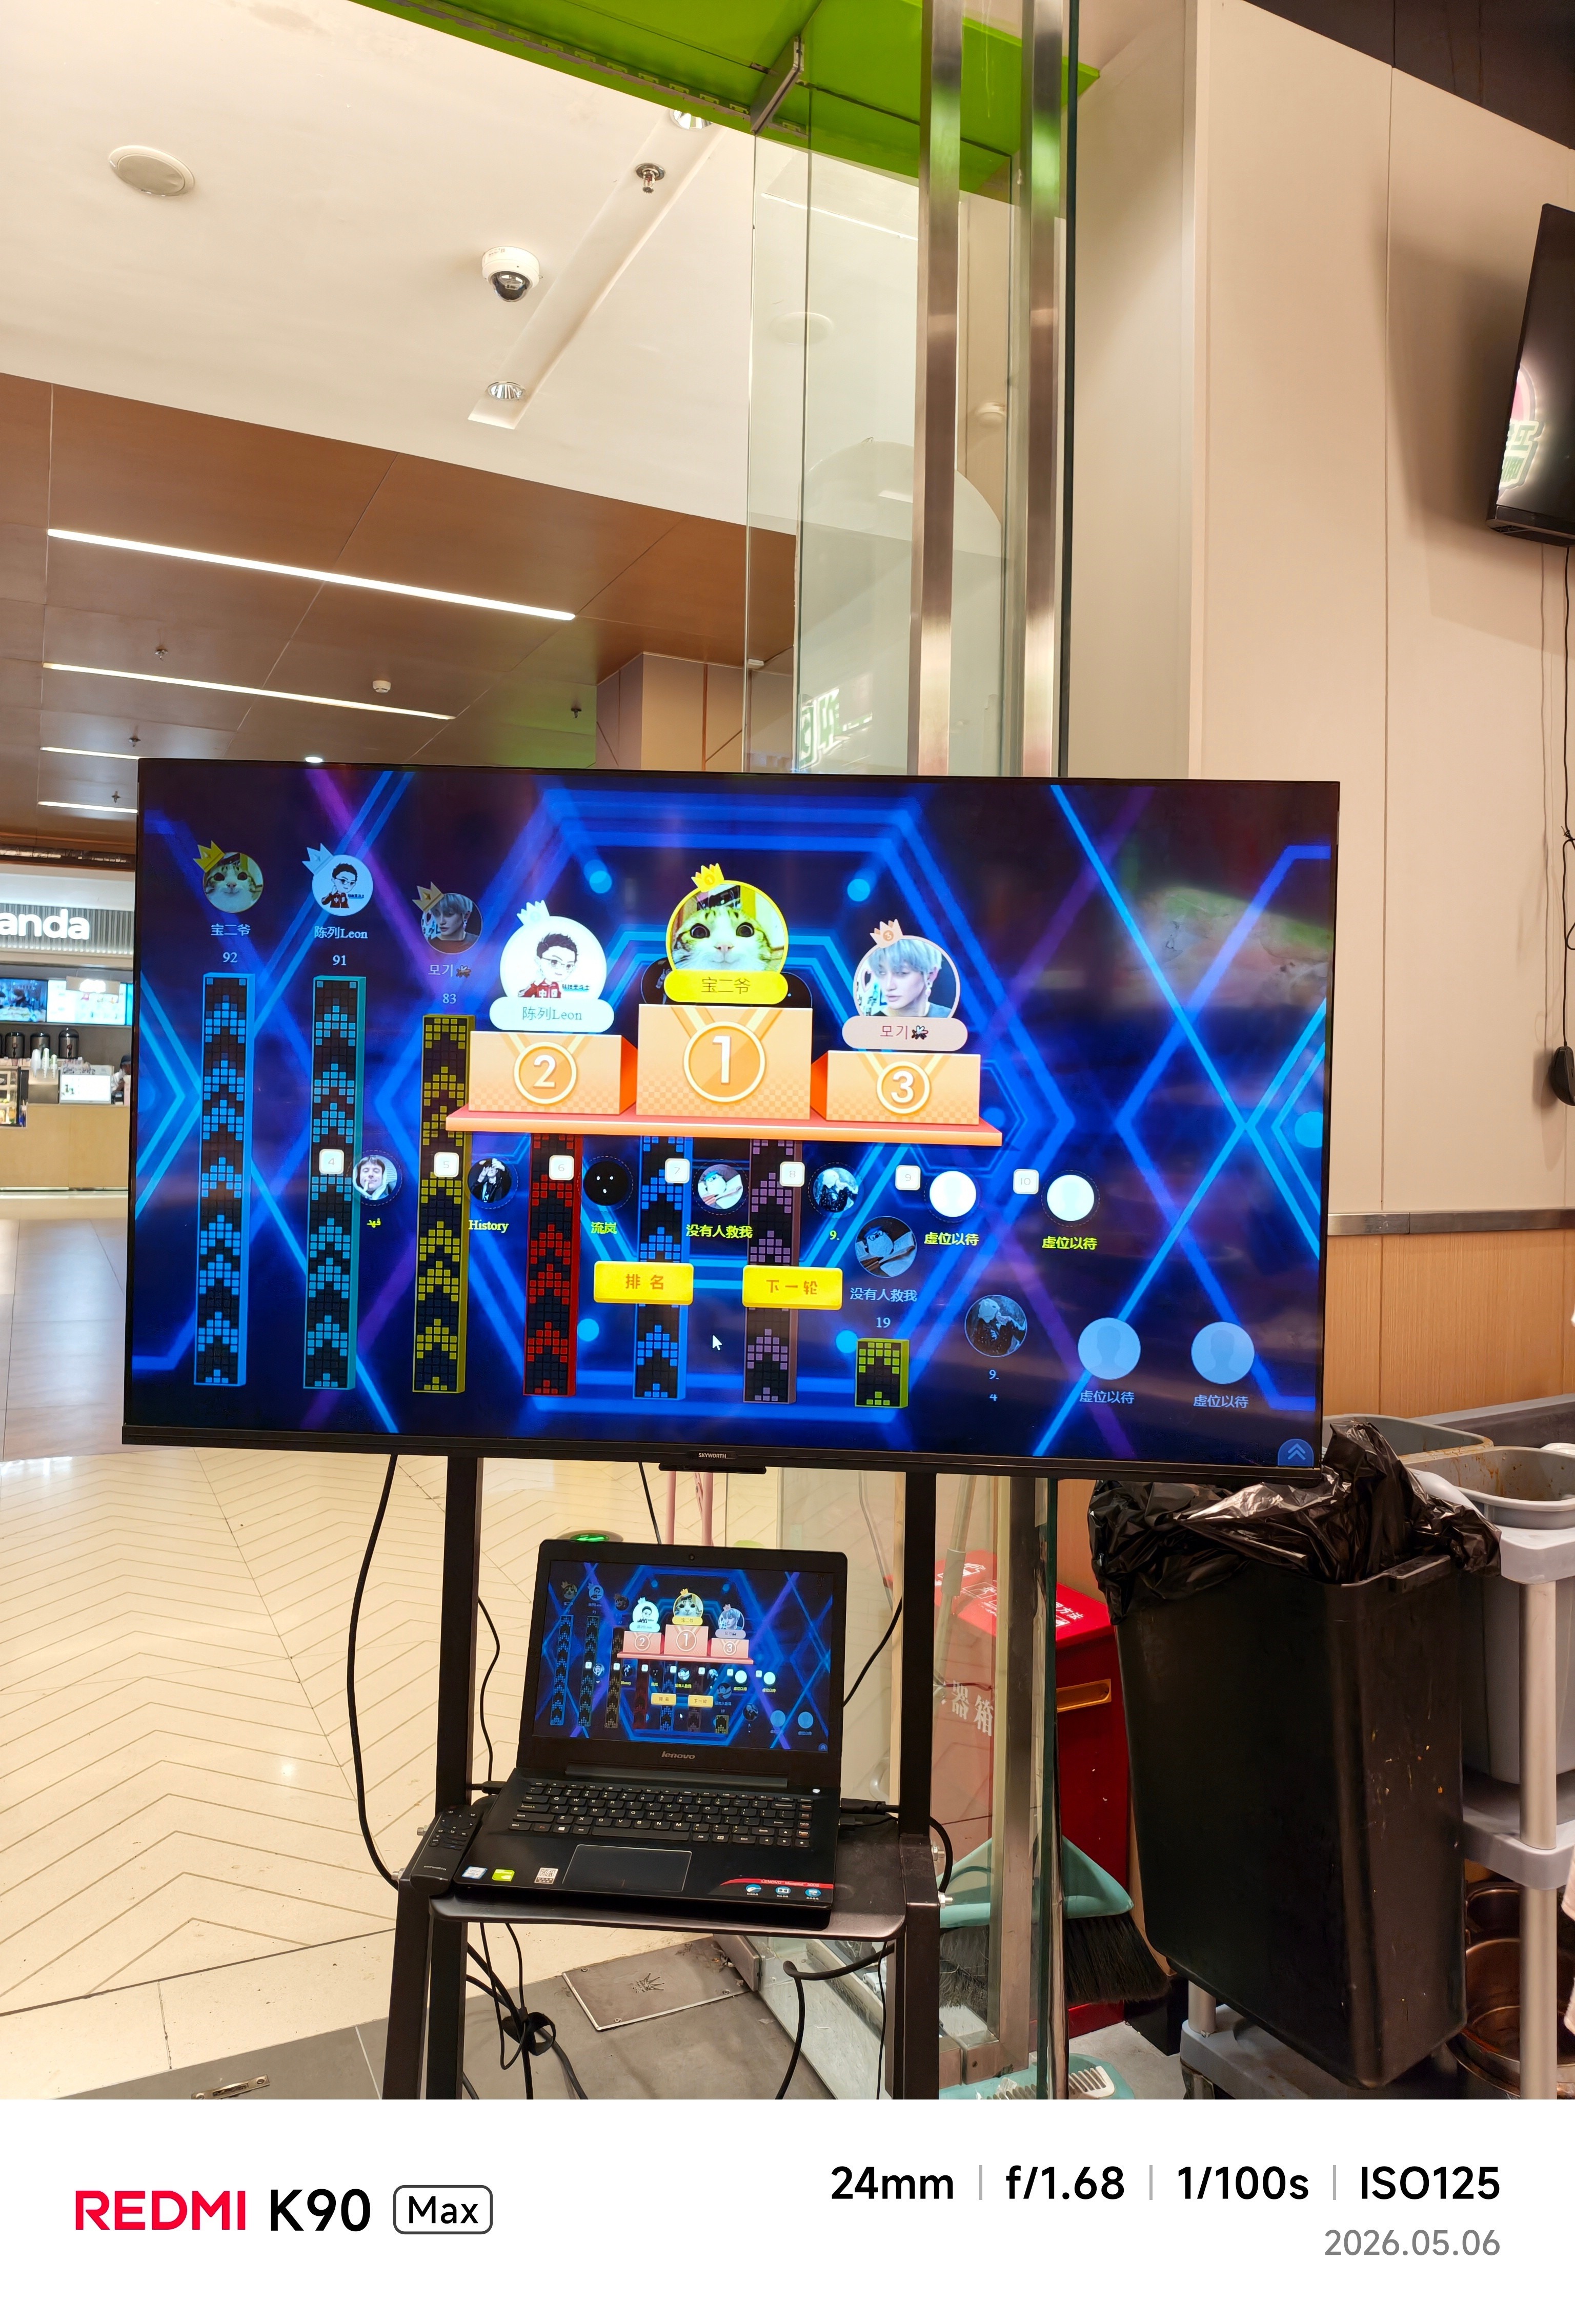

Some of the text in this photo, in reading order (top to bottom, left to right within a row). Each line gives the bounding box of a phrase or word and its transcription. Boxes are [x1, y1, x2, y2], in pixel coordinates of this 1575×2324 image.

[0, 909, 90, 940] anda
[211, 923, 251, 937] 宝二爷
[314, 926, 368, 940] 陈列Leon
[223, 952, 238, 963] 92
[332, 955, 347, 966] 91
[428, 964, 454, 977] 모기
[701, 977, 750, 994] 宝二爷
[442, 993, 457, 1005] 83
[522, 1006, 582, 1021] 陈列Leon
[880, 1025, 908, 1040] 모기
[712, 1035, 731, 1084] 1
[533, 1054, 557, 1088] 2
[890, 1071, 914, 1103] 3
[328, 1157, 335, 1166] 4
[674, 1167, 680, 1175] 7
[1021, 1177, 1031, 1186] 10
[468, 1219, 509, 1233] History
[591, 1221, 617, 1234] 流岚
[686, 1224, 753, 1239] 没有人救我
[924, 1232, 979, 1246] 虚位以待
[1042, 1236, 1098, 1250] 虚位以待
[625, 1273, 665, 1290] 排名
[766, 1279, 818, 1296] 下一轮
[850, 1288, 918, 1302] 没有人救我
[876, 1317, 891, 1329] 19
[989, 1394, 998, 1402] 4
[1079, 1390, 1135, 1405] 虚位以待
[1193, 1394, 1249, 1409] 虚位以待
[639, 1638, 645, 1647] 2
[683, 1633, 689, 1646] 1
[726, 1644, 733, 1652] 3
[941, 1680, 994, 1737] 器箱
[661, 1751, 695, 1759] lenovo
